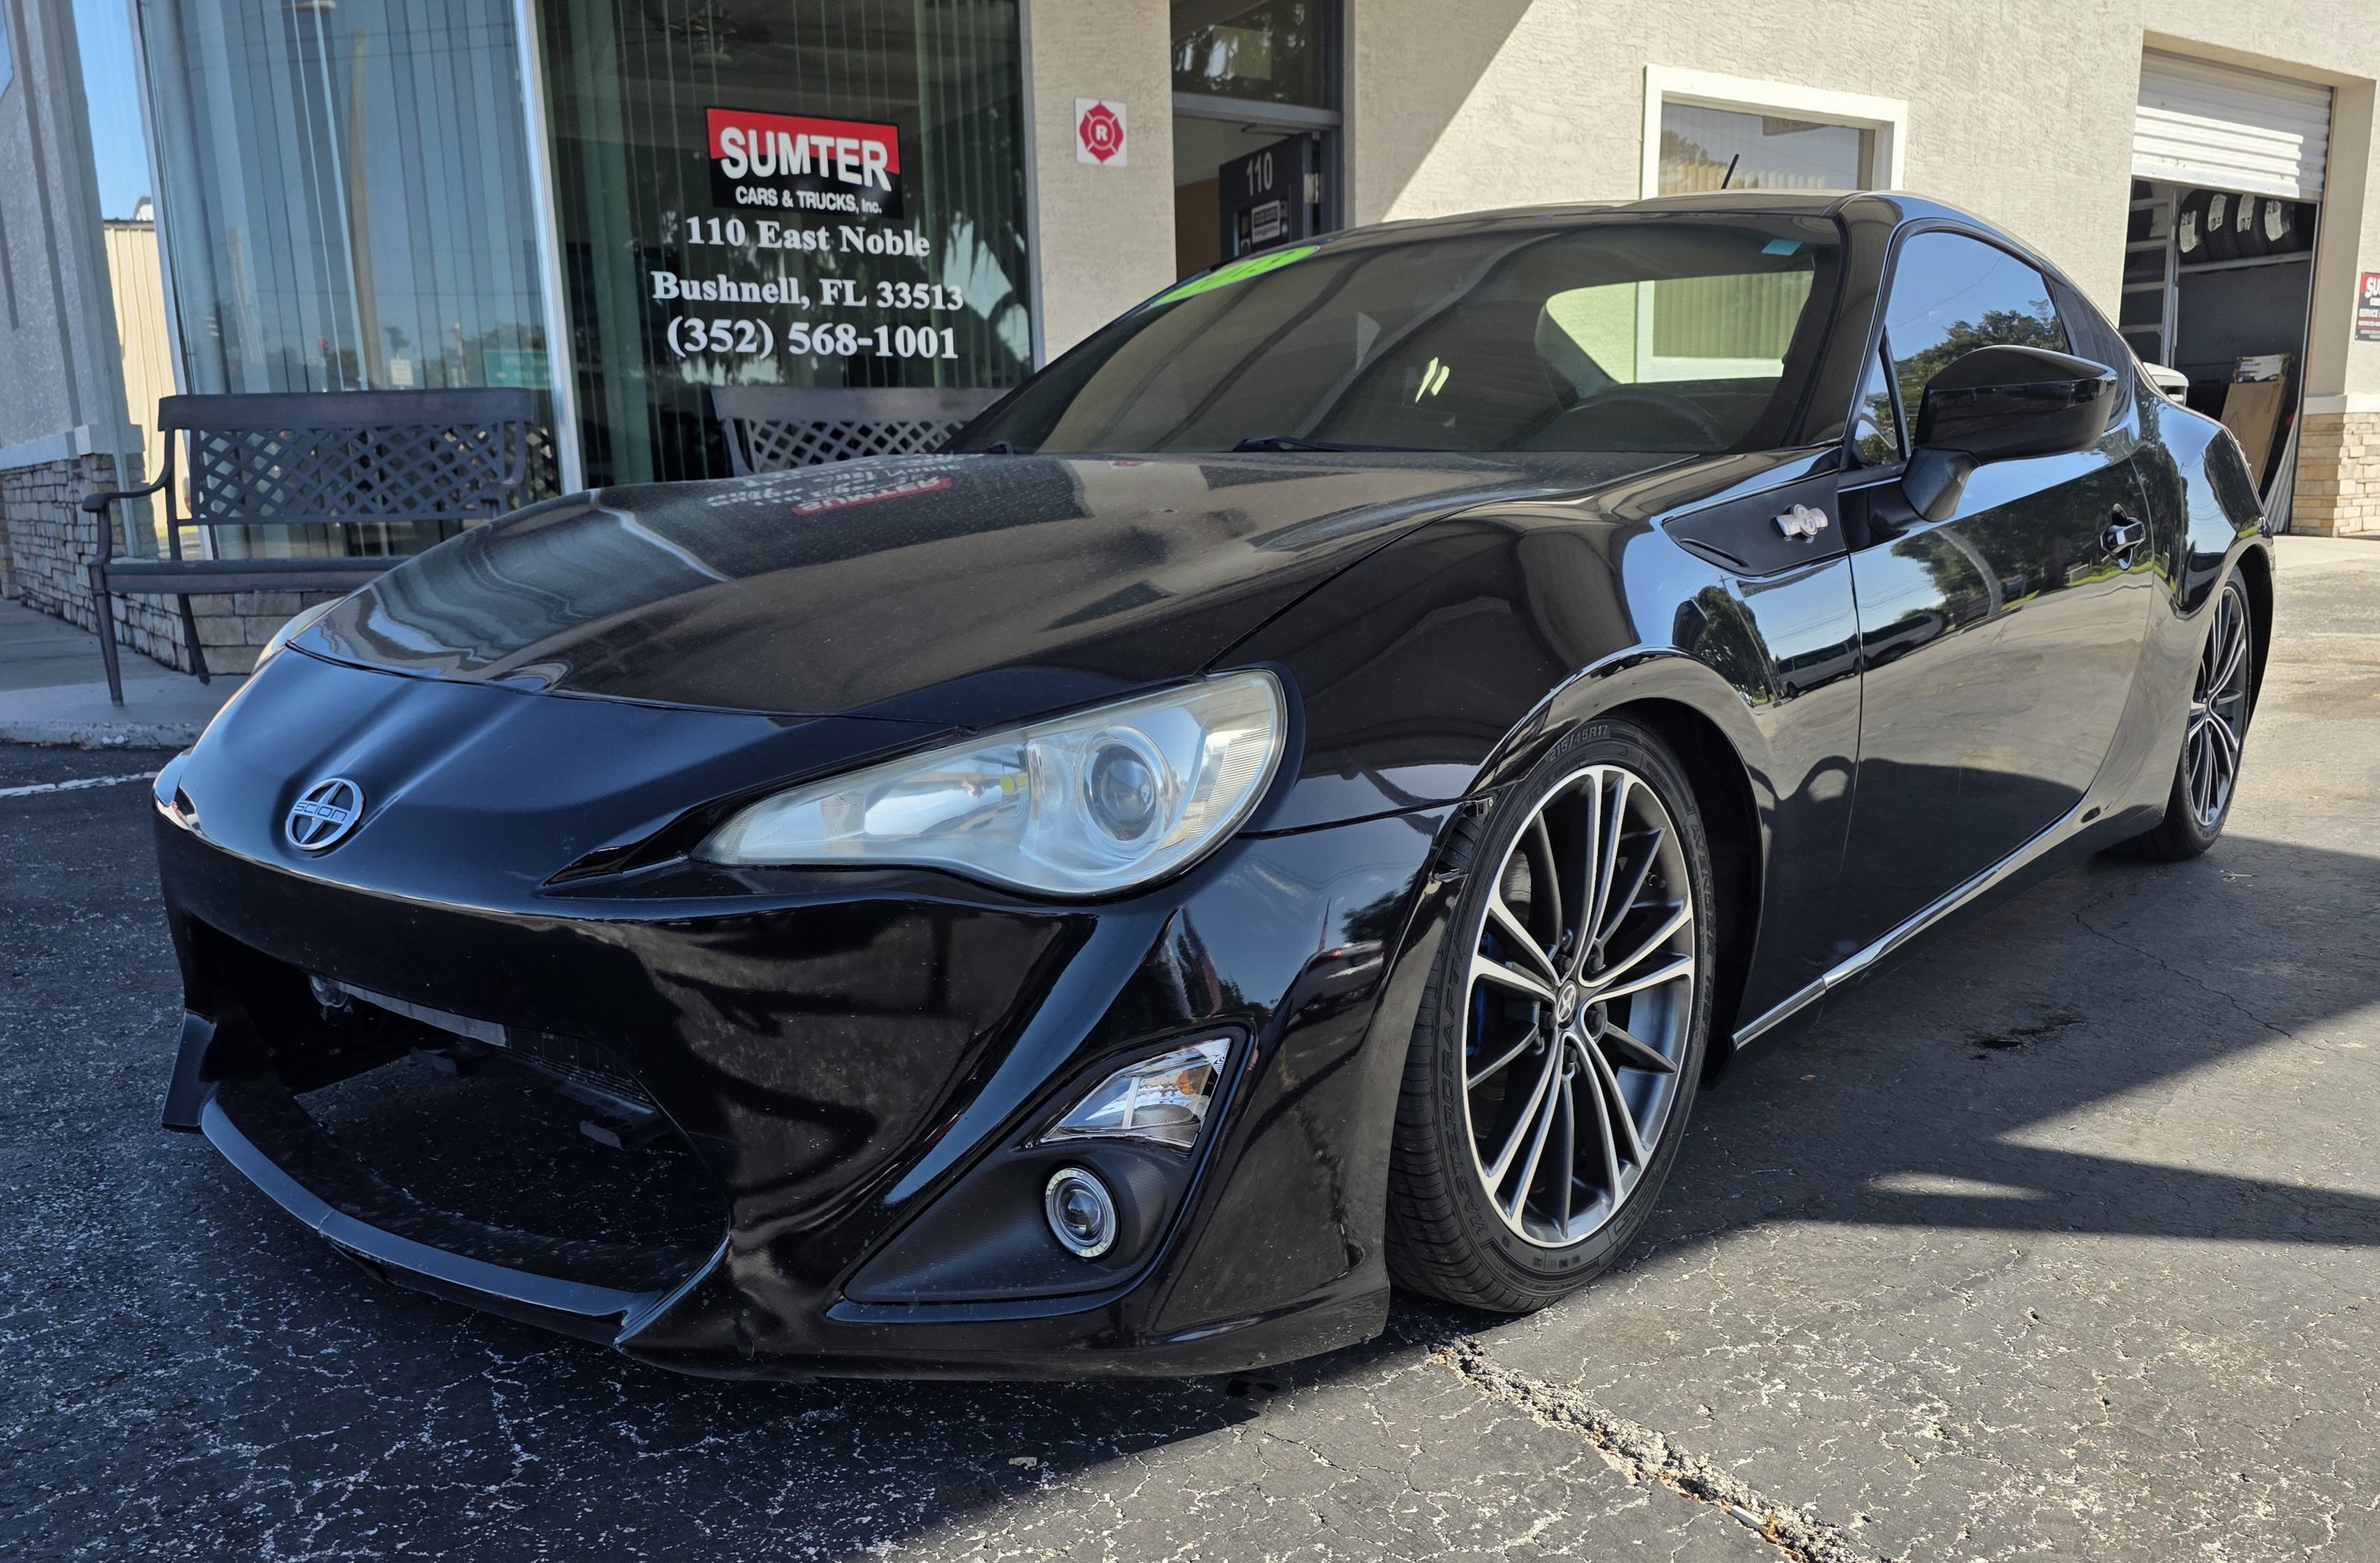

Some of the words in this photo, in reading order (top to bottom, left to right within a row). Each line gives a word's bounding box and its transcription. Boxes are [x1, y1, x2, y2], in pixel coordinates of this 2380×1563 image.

[1095, 125, 1108, 141] R
[720, 127, 892, 192] SUMTER
[1246, 152, 1273, 197] 110
[735, 185, 778, 207] CARS
[781, 190, 794, 208] &
[796, 190, 860, 214] TRUCKS,
[861, 199, 882, 214] Inc.
[686, 216, 746, 247] 110
[755, 220, 830, 252] East
[838, 225, 931, 257] Noble
[650, 270, 810, 310] Bushnell,
[819, 278, 867, 307] FL
[876, 281, 964, 311] 33513
[667, 316, 775, 359] (352)
[788, 322, 959, 360] 568-1001
[1442, 956, 1489, 1238] MASTERCRAFT
